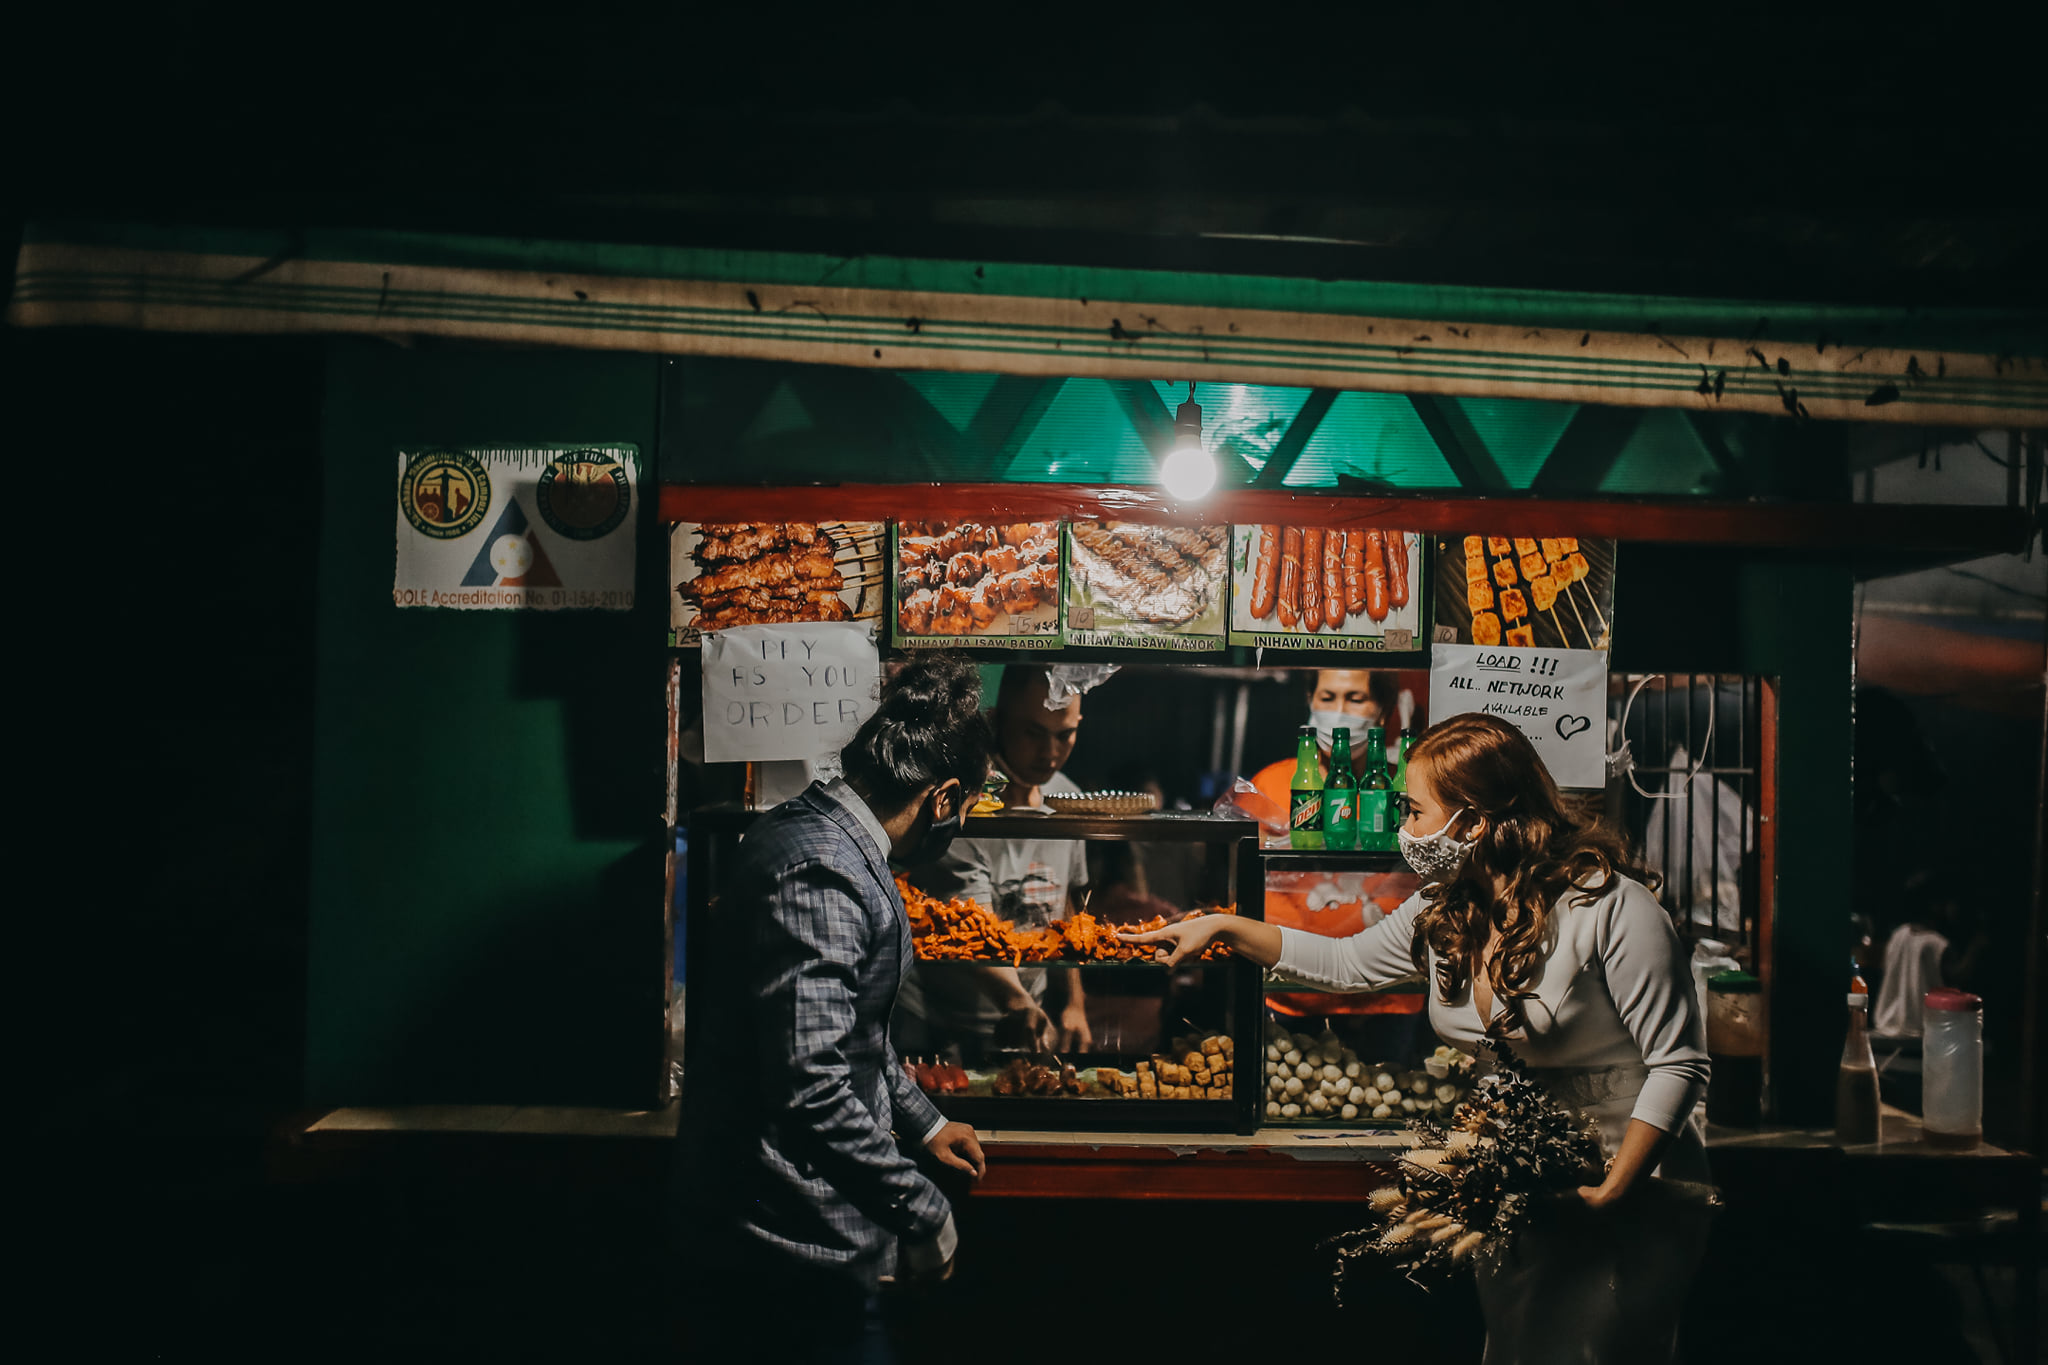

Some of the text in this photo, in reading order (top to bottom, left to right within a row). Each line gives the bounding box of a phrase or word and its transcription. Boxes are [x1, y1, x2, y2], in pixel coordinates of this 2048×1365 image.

[394, 589, 427, 605] DOLE
[431, 589, 521, 606] Accreditation
[525, 590, 546, 605] No.
[1075, 612, 1089, 625] 10
[904, 639, 950, 648] INIHAW
[975, 639, 1006, 648] ISAW
[1010, 640, 1053, 649] BABOY
[1069, 633, 1216, 650] INIHAW NA ISAW MANOK
[1254, 636, 1385, 650] INIHAW NA HOTDOG
[1391, 632, 1409, 646] 20
[1439, 630, 1452, 643] 10
[1476, 652, 1559, 676] LOAD !!!
[801, 665, 857, 687] YOU
[1487, 680, 1565, 700] NETWORK
[726, 699, 860, 728] ORDER
[1482, 702, 1548, 716] AVAILABLE
